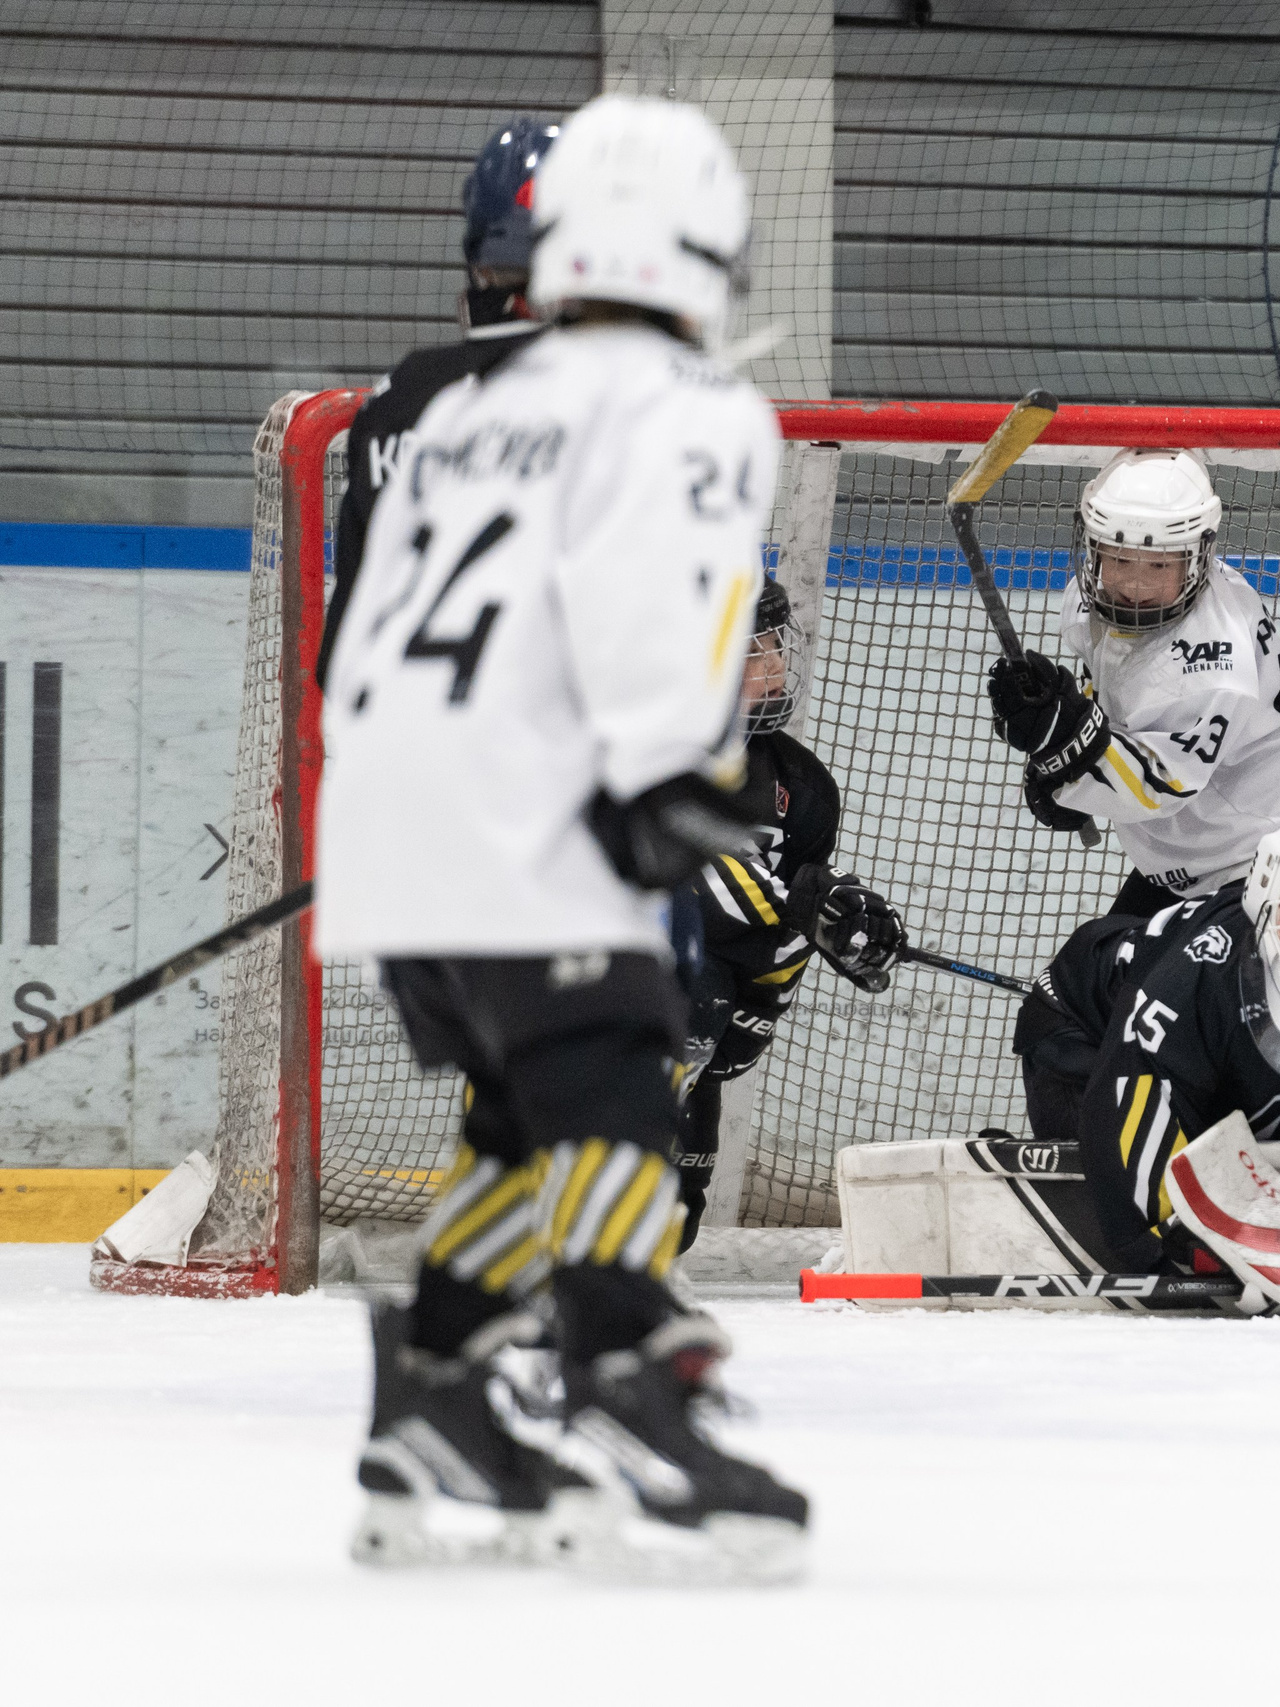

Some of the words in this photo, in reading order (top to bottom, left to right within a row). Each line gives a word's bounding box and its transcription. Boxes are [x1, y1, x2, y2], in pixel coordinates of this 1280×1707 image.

[1182, 663, 1212, 675] ARENA
[1214, 661, 1233, 671] PLAY
[1169, 714, 1230, 764] 43
[950, 962, 997, 981] NEXUS
